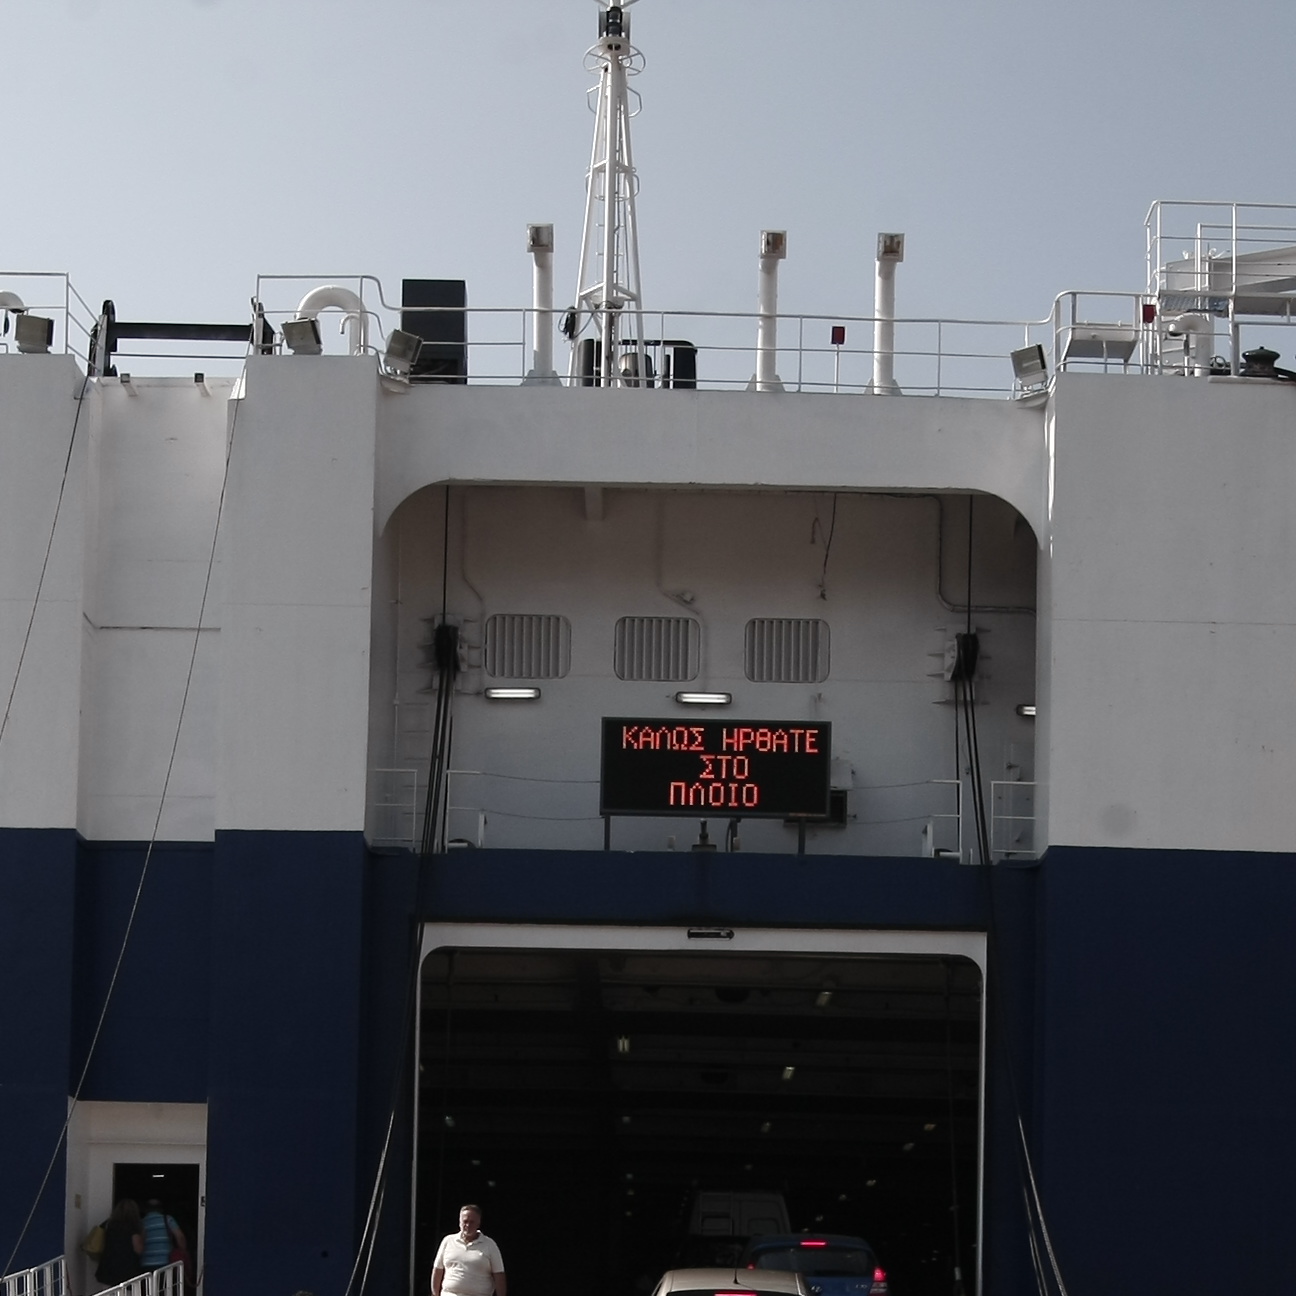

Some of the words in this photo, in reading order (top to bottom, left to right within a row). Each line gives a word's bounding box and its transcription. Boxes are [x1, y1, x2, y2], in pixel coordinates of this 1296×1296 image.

[622, 726, 705, 750] ΚΑΛΩΣ
[722, 728, 819, 753] ΗΡΘΑΤΕ
[699, 755, 749, 779] ΣΤΟ
[670, 782, 758, 807] ΠΛΟΙΟ
